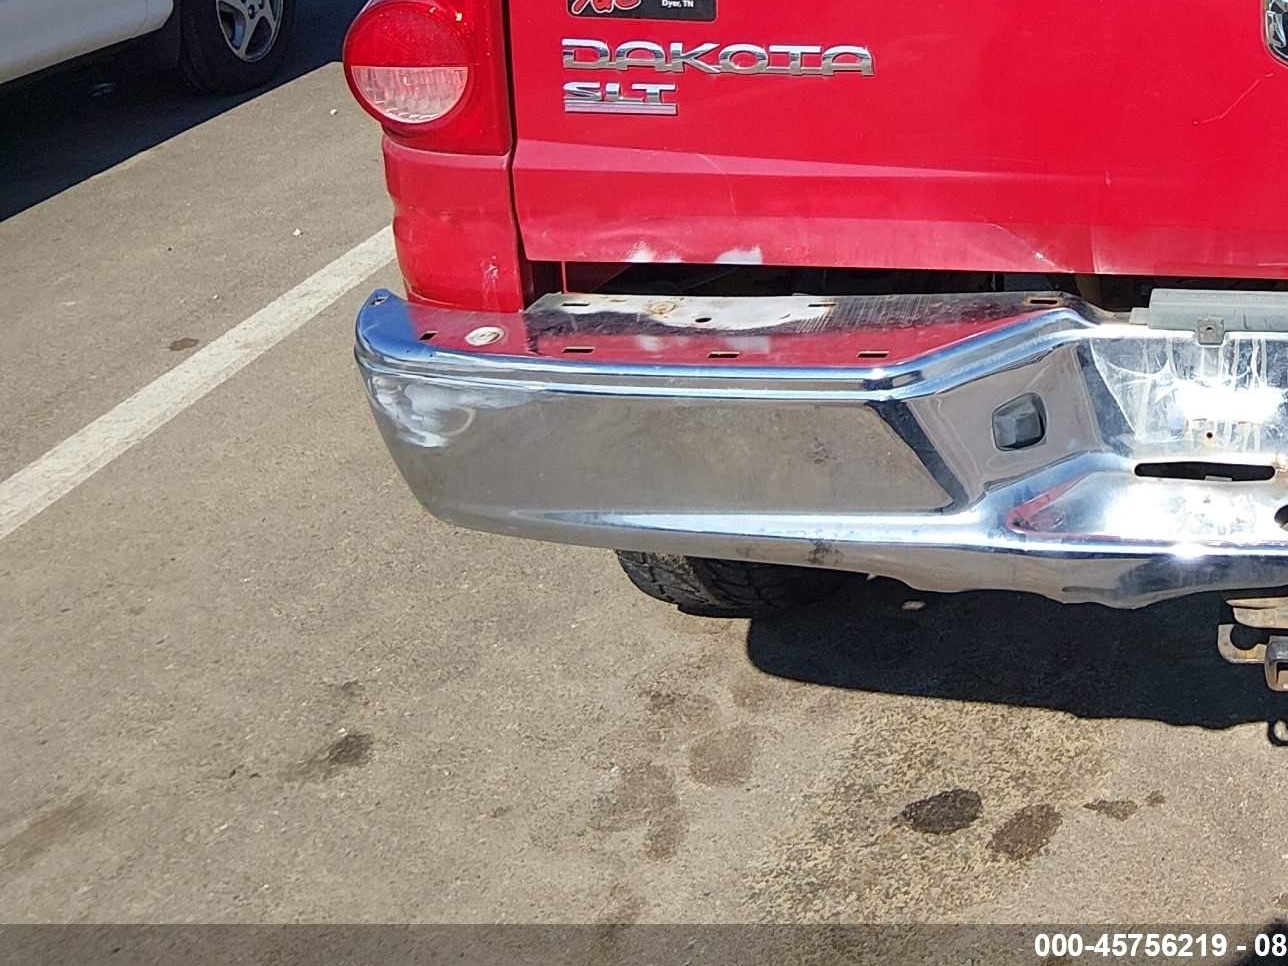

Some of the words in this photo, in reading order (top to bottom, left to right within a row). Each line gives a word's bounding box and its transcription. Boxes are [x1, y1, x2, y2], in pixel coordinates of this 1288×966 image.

[661, 0, 682, 8] Dyer,
[682, 0, 694, 7] TN
[562, 39, 873, 75] DAKOTA
[562, 82, 676, 104] SLT
